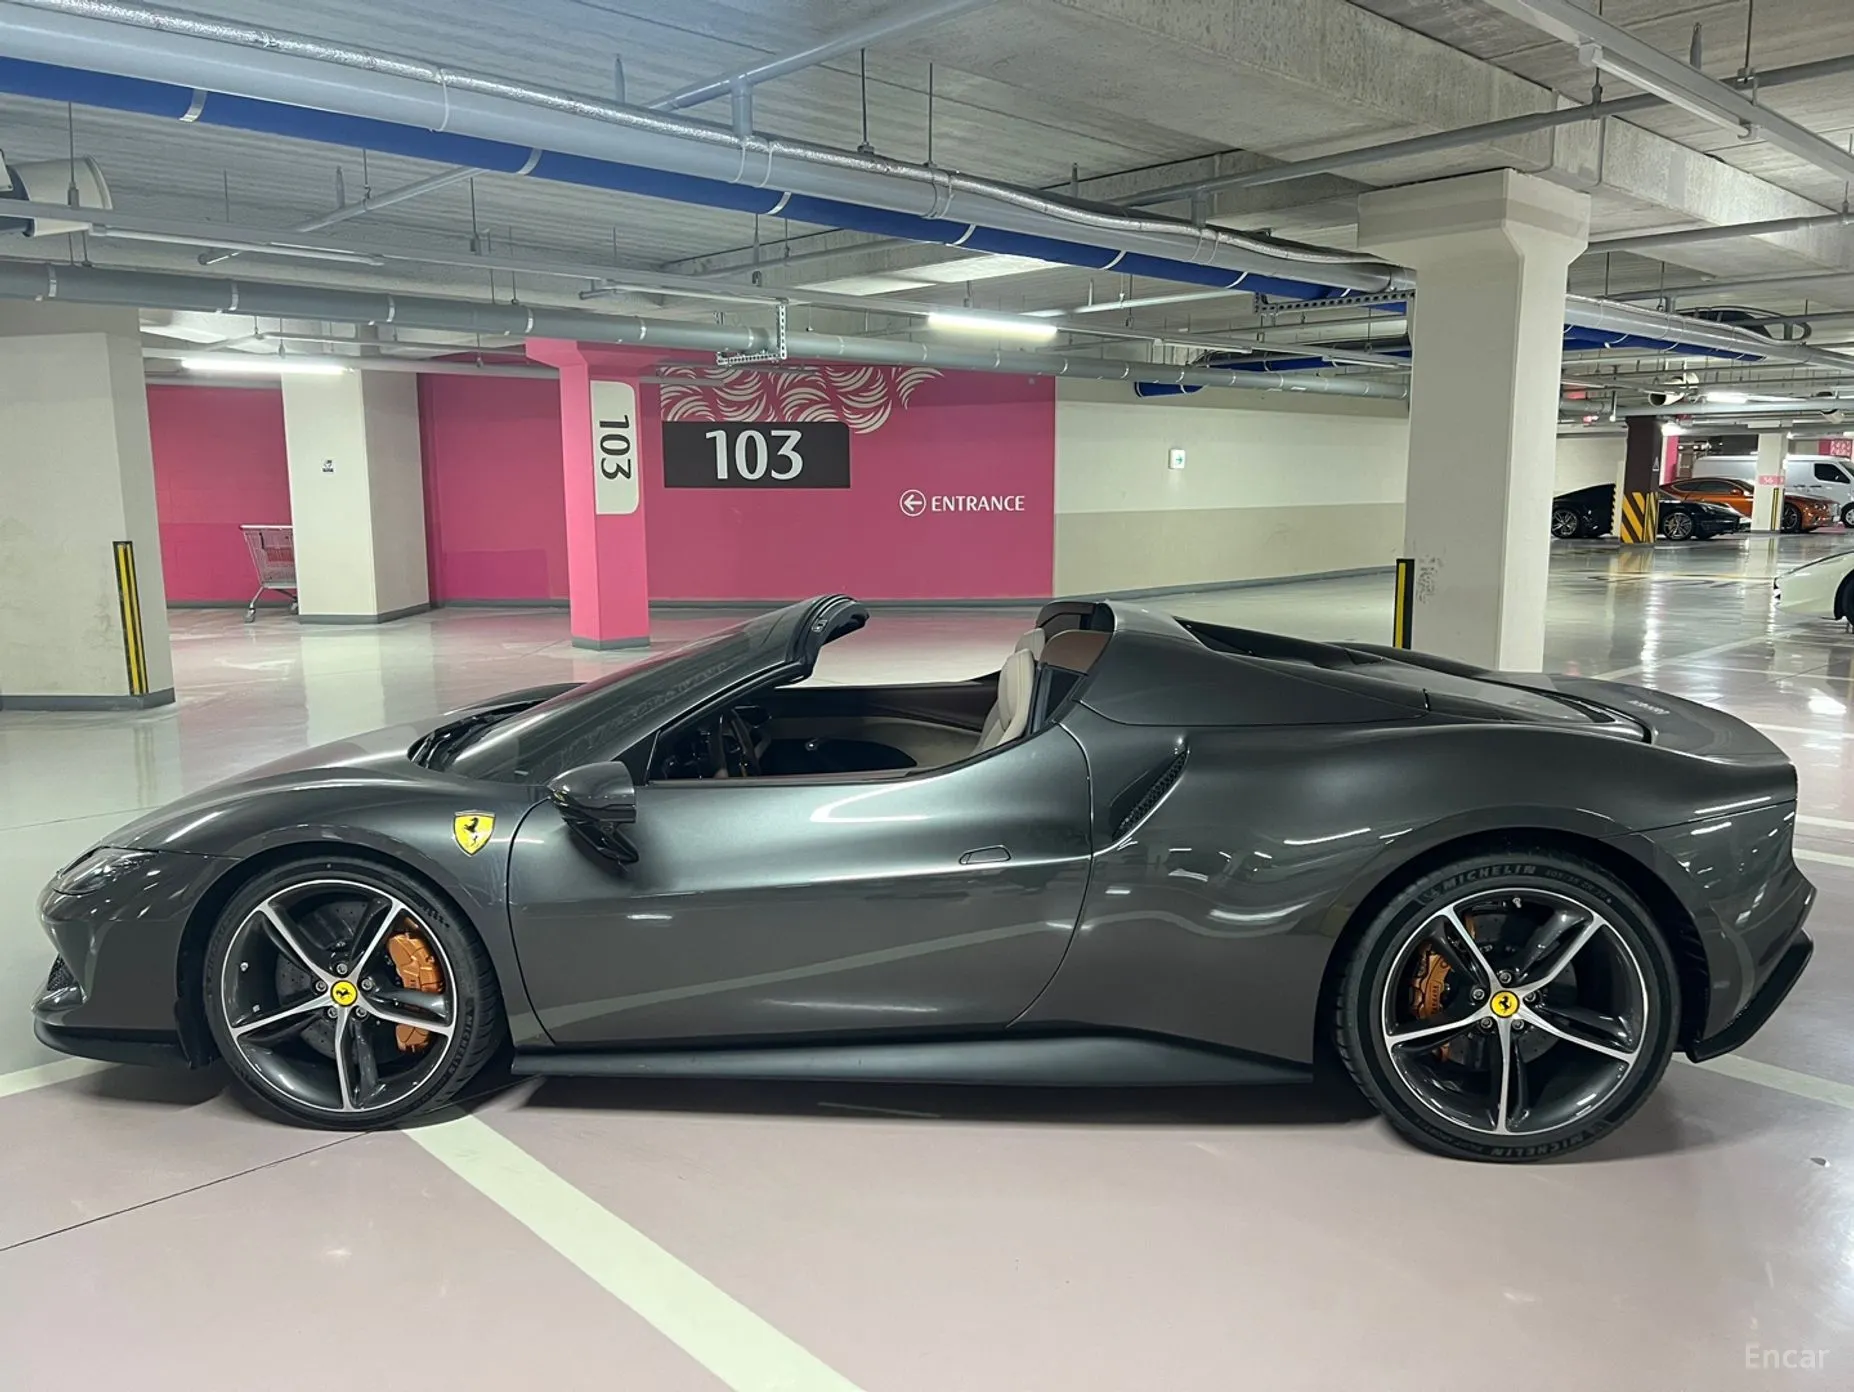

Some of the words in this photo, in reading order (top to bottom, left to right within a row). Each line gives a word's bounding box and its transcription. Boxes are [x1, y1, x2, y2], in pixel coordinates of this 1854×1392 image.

[598, 414, 632, 481] 103
[704, 429, 805, 481] 103
[931, 495, 1025, 512] ENTRANCE
[1443, 864, 1537, 891] MICHELIN
[447, 1014, 473, 1075] MICHELIN
[1490, 1129, 1584, 1156] MICHELIN
